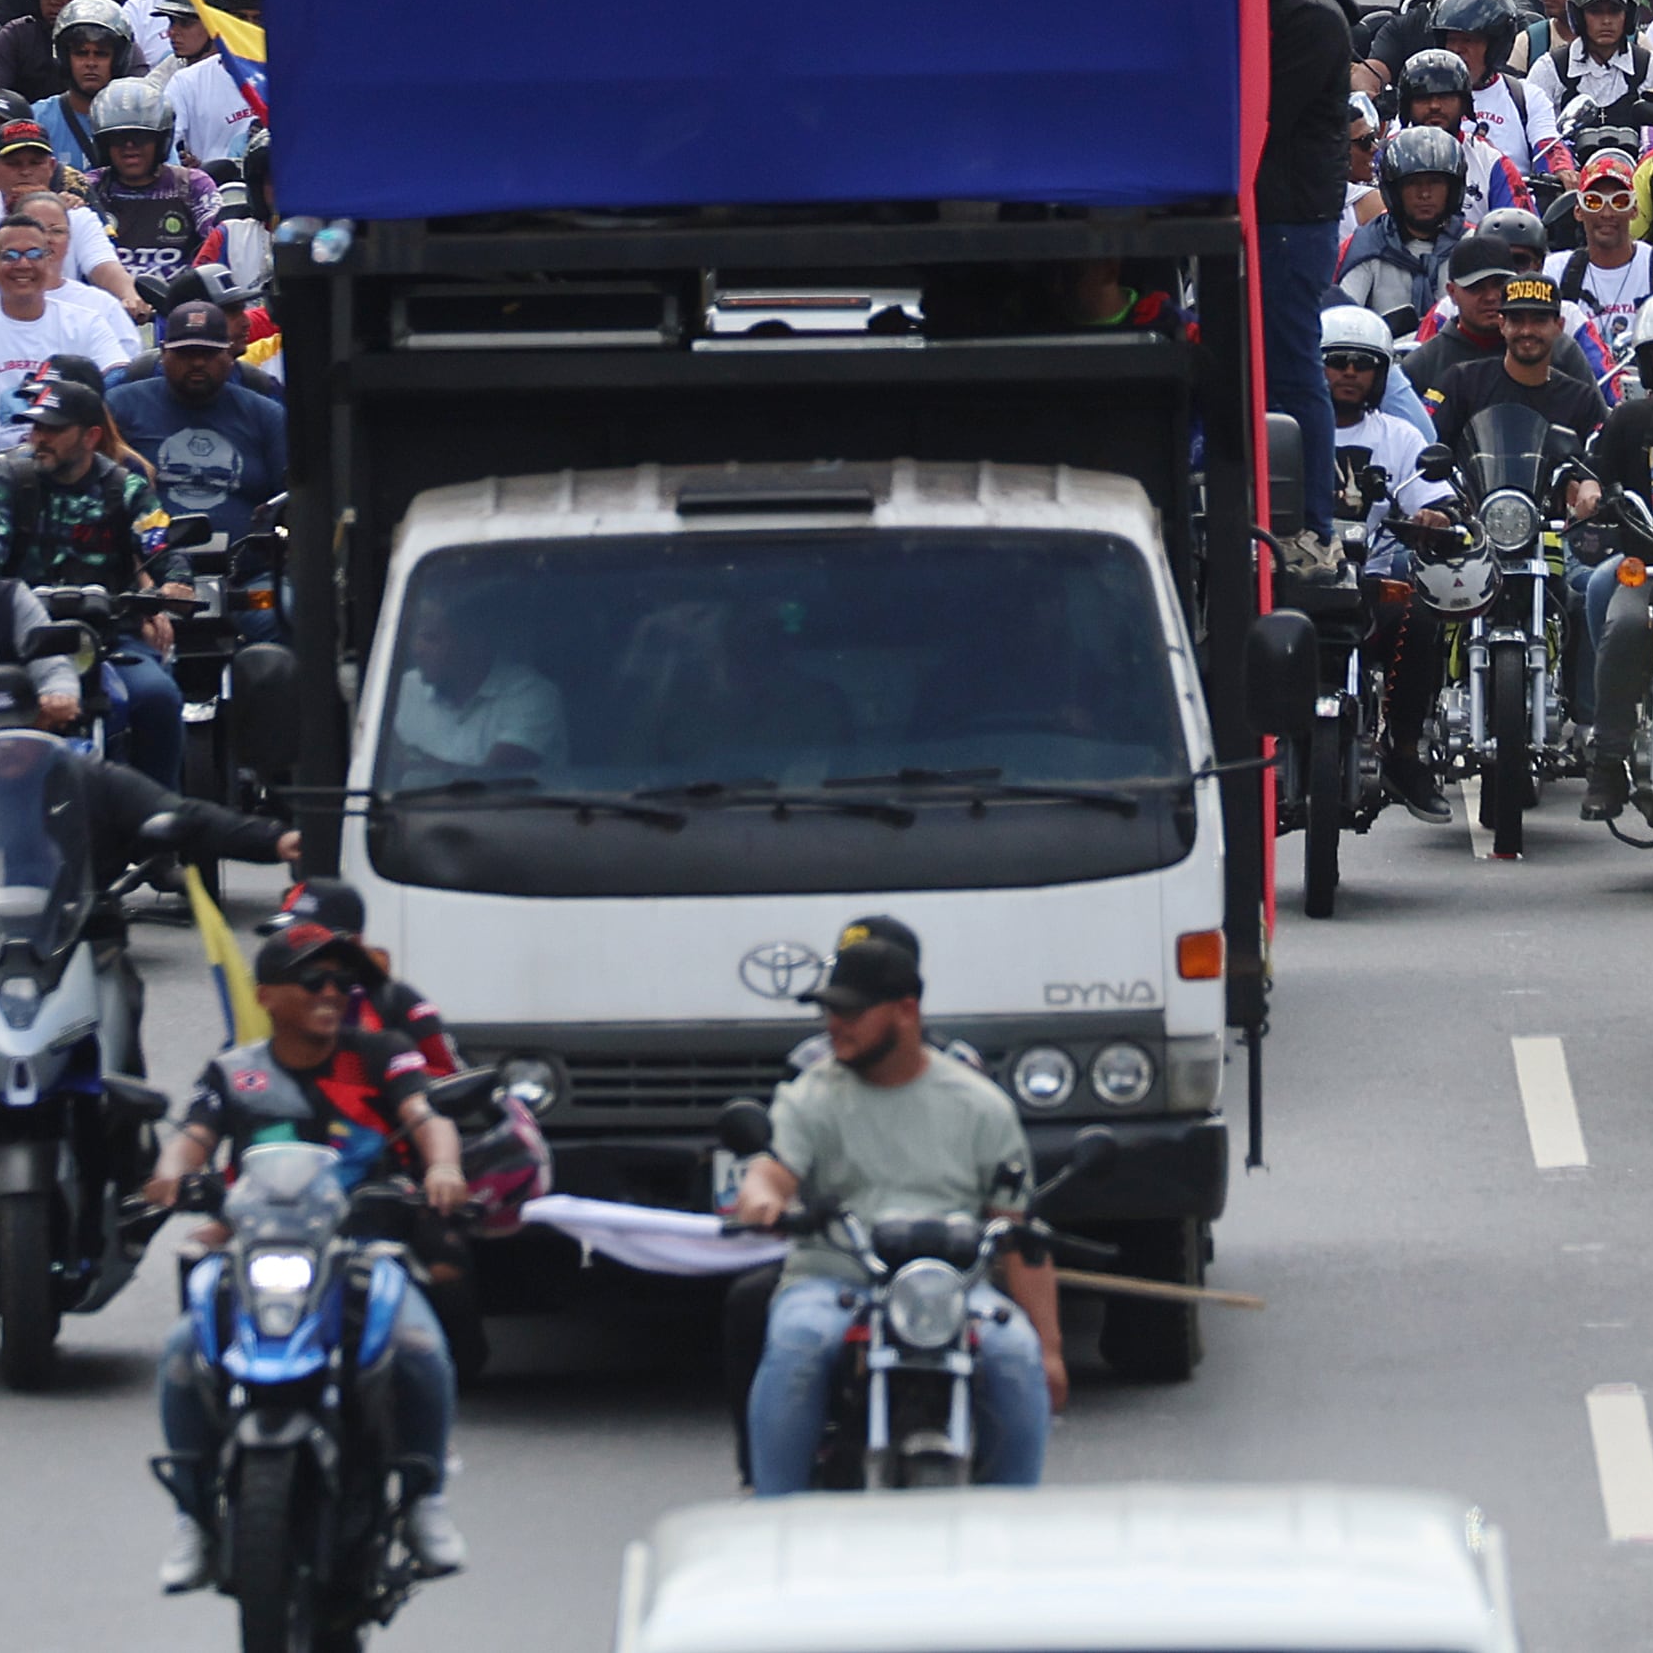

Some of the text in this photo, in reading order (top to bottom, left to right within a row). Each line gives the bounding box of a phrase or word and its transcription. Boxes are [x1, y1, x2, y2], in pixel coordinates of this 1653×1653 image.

[116, 248, 182, 264] OTO
[1506, 280, 1553, 303] SINBOM
[1043, 981, 1156, 1008] DYNA
